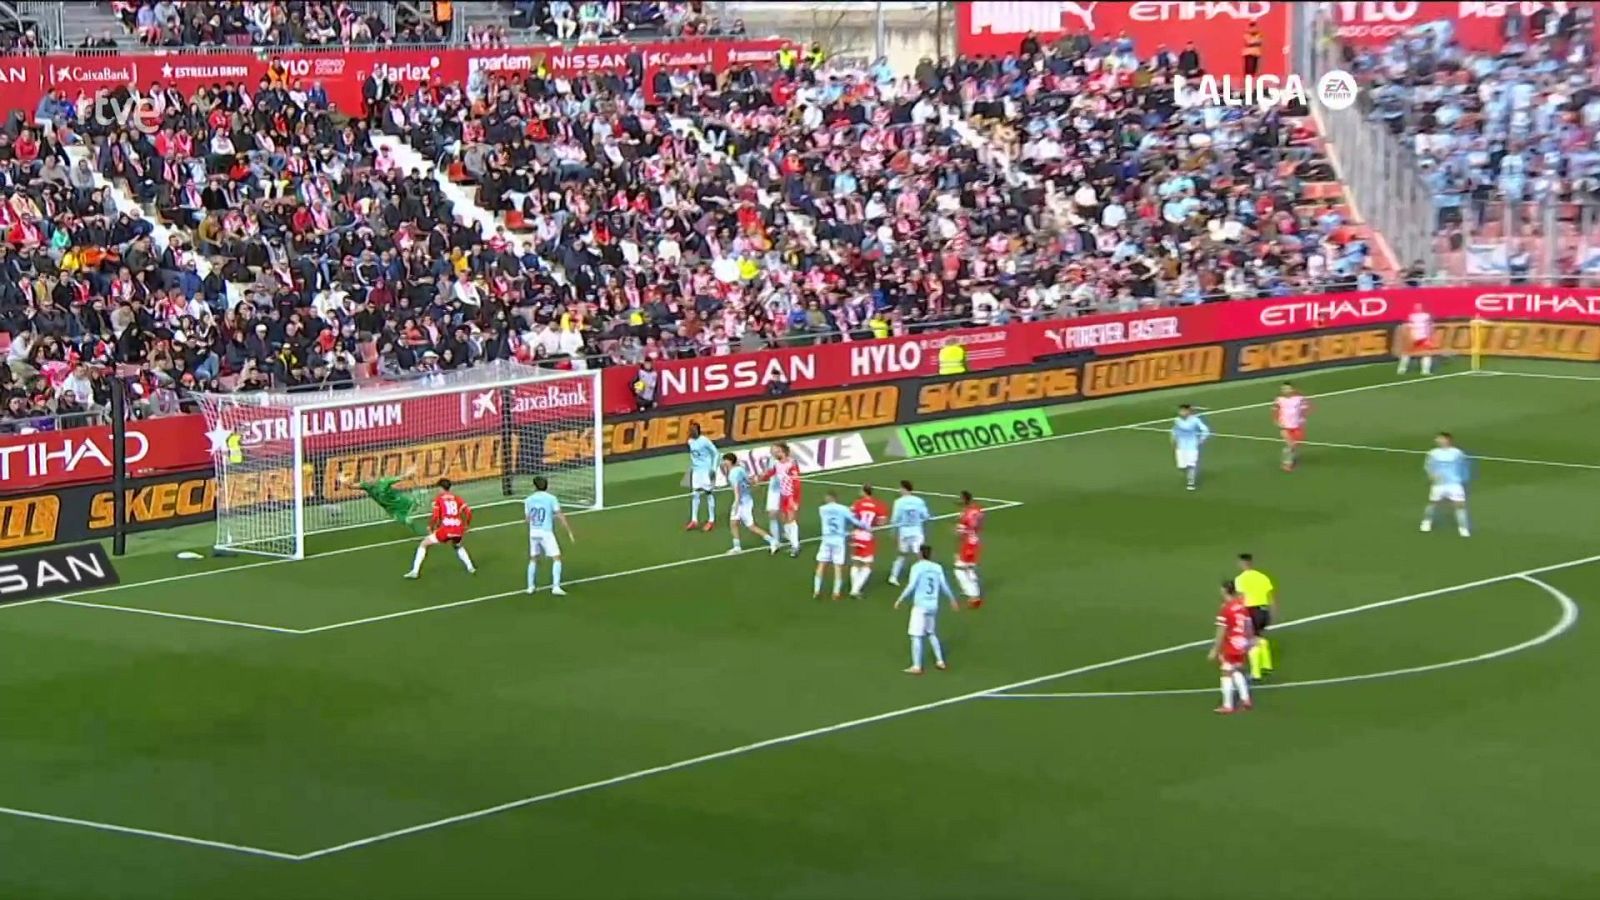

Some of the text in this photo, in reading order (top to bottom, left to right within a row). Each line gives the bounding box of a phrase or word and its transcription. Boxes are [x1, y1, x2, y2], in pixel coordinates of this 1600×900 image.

[73, 67, 130, 82] CaixaBank
[552, 54, 626, 70] NISSAN
[1260, 297, 1388, 326] ETIHAD
[851, 340, 921, 377] HYLO
[661, 355, 816, 396] NISSAN
[916, 367, 1079, 414] SKECHERS
[340, 403, 402, 432] DAMM
[742, 391, 888, 435] FOOTBALL
[542, 409, 726, 465] SKECHERS
[444, 501, 458, 516] 18
[530, 507, 546, 526] 20
[0, 552, 106, 594] SAN
[926, 577, 935, 596] 3
